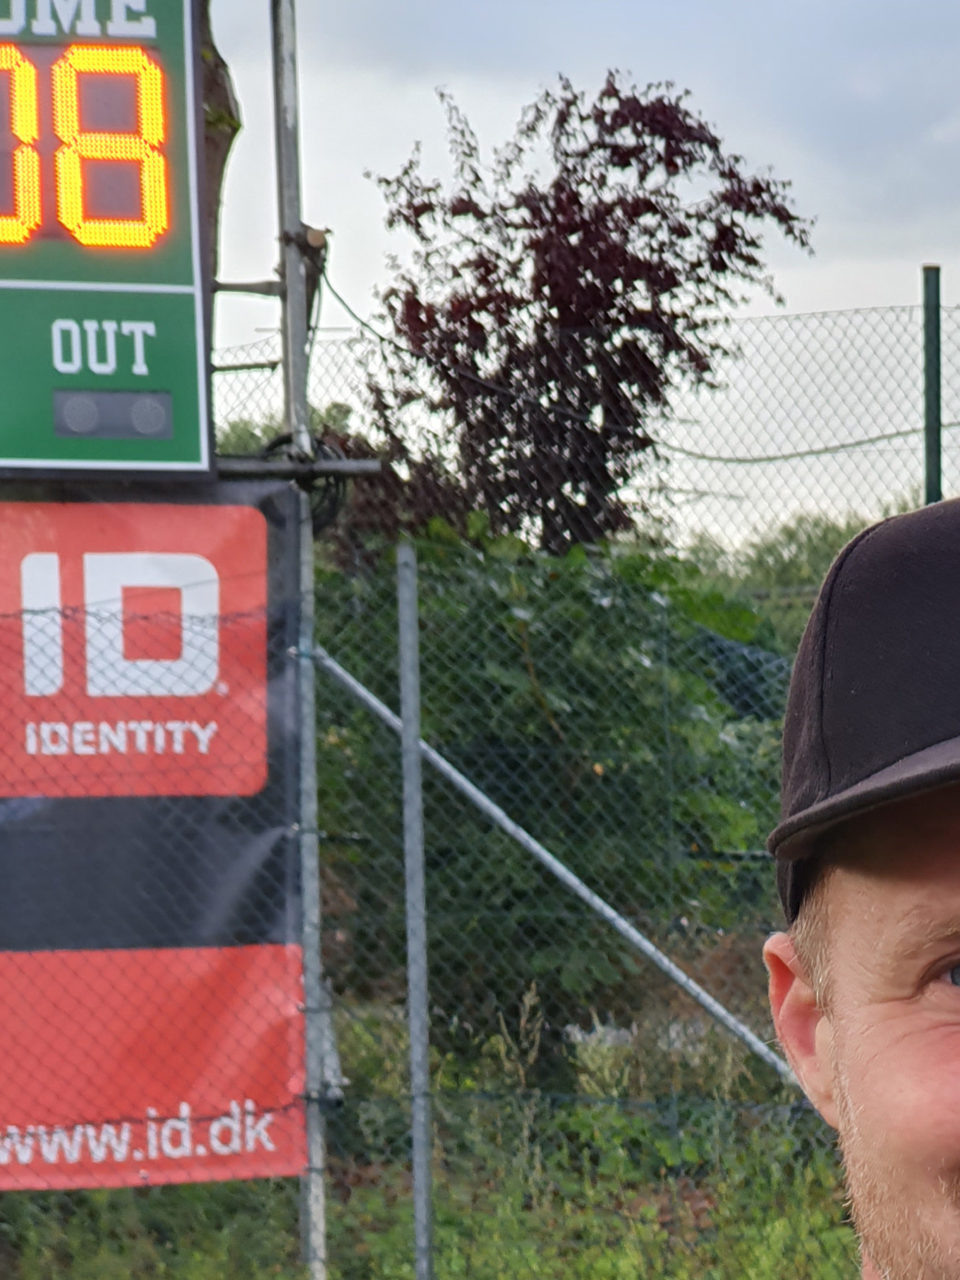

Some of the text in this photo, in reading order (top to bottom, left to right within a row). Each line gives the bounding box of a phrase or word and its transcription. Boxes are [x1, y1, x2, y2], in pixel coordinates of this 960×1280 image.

[52, 318, 156, 375] OUT
[21, 552, 220, 697] ID
[25, 719, 218, 755] IDENTITY
